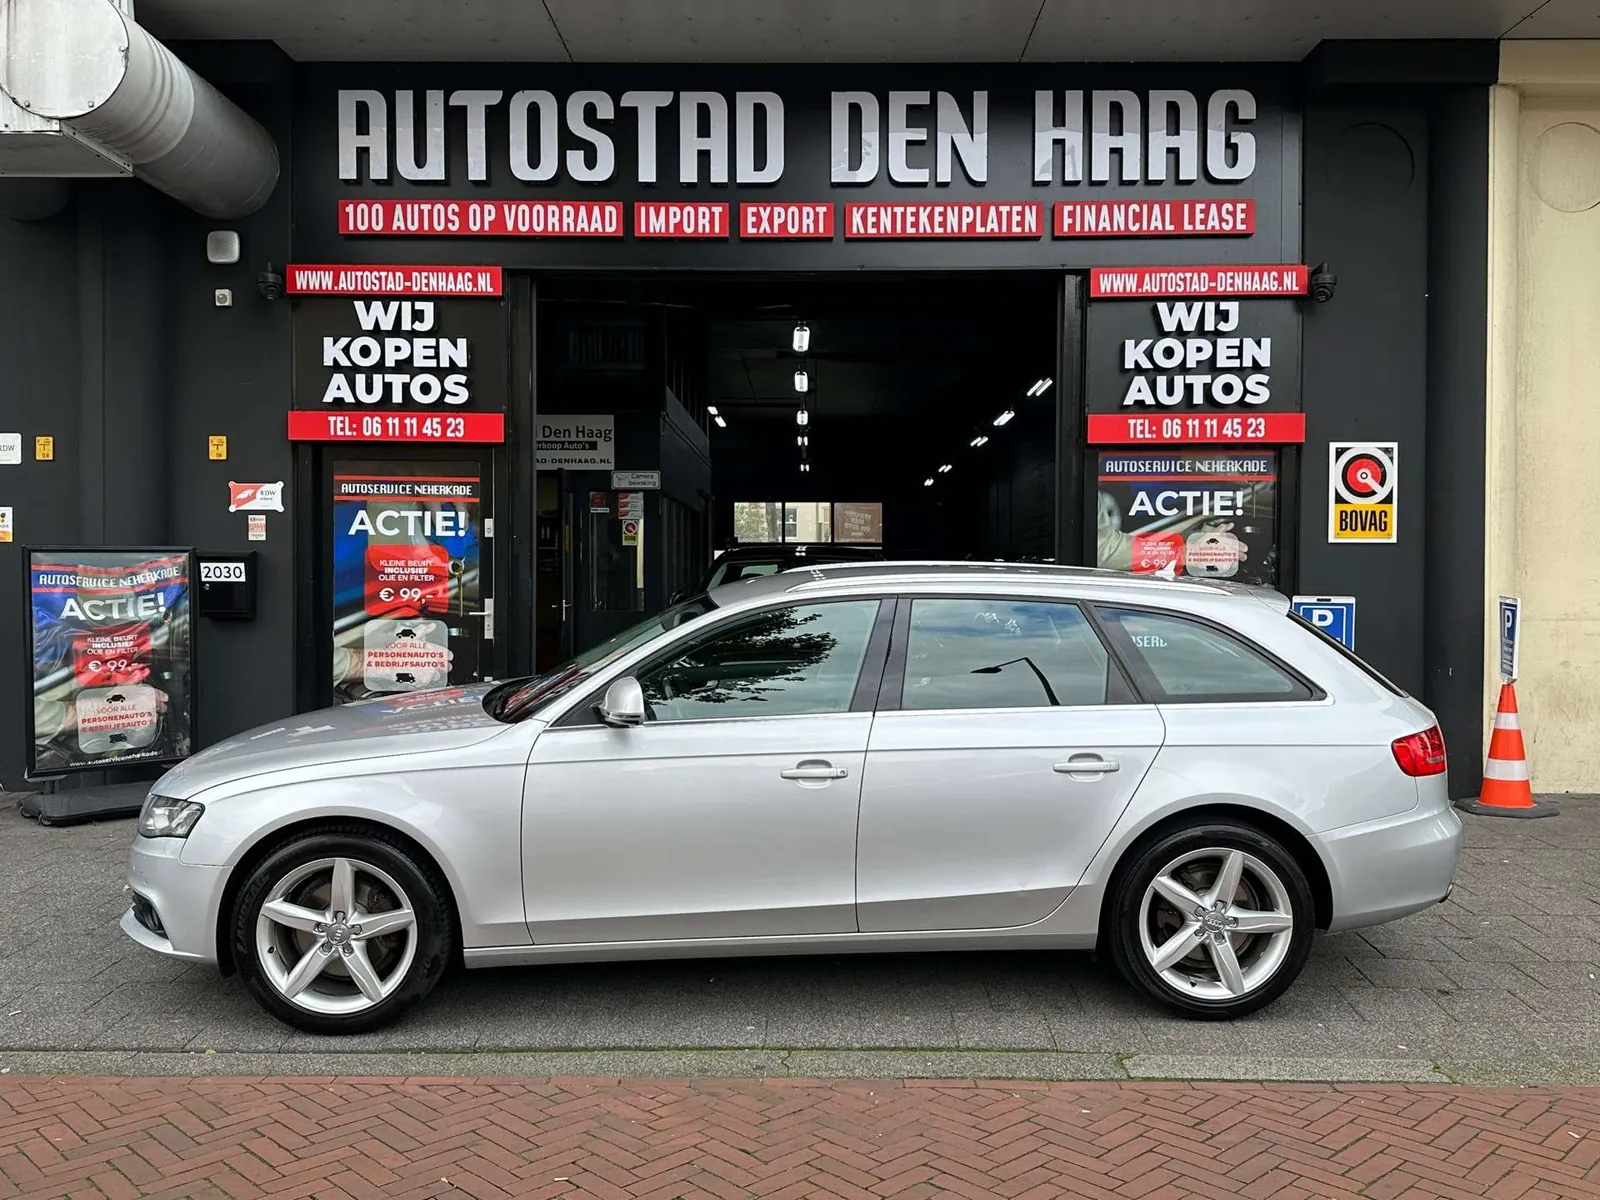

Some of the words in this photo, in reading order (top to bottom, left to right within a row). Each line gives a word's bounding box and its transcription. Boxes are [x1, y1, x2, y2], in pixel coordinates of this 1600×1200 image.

[338, 89, 785, 184] AUTOSTAD
[830, 90, 988, 184] DEN
[1033, 89, 1257, 183] HAAG
[344, 204, 384, 231] 100
[392, 204, 461, 233] AUTOS
[468, 205, 496, 233] OP
[502, 205, 618, 234] VOORRAAD
[640, 206, 723, 234] IMPORT
[746, 206, 827, 234] EXPORT
[851, 205, 1038, 234] KENTEKENPLATEN
[1062, 204, 1175, 232] FINANCIAL
[1182, 203, 1247, 231] LEASE
[295, 270, 494, 293] WWW.AUTOSTAD-DENHAAG.NL
[1100, 271, 1299, 293] WWW.AUTOSTAD-DENHAAG.NL
[353, 300, 435, 332] WIJ
[1156, 301, 1240, 332] WIJ
[323, 336, 468, 368] KOPEN
[1124, 337, 1271, 369] KOPEN
[322, 373, 469, 404] AUTOS
[1122, 373, 1270, 405] AUTOS
[328, 416, 357, 436] TEL:
[362, 416, 382, 436] 06
[386, 416, 400, 436] 11
[404, 417, 417, 437] 11
[422, 417, 442, 437] 45
[446, 417, 465, 437] 23
[542, 425, 571, 439] Den
[576, 425, 613, 442] Haag
[1128, 418, 1157, 438] TEL:
[1162, 418, 1182, 438] 06
[1186, 418, 1200, 438] 11
[1204, 418, 1218, 437] 11
[1222, 418, 1242, 437] 45
[1247, 417, 1266, 437] 23
[563, 442, 589, 450] Auto's
[1105, 460, 1193, 473] AUTOSERVICE
[1195, 460, 1268, 473] NEHERKADE
[341, 483, 412, 495] AUTOSERVICE
[414, 484, 472, 496] NEHERKADE
[1128, 490, 1244, 516] ACTIE!
[347, 509, 466, 537] ACTIE!
[1339, 510, 1388, 532] BOVAG
[203, 566, 243, 579] 2030
[379, 559, 406, 567] KLEINE
[407, 559, 432, 567] BEURT
[384, 567, 429, 575] INCLUSIEF
[1141, 559, 1151, 568] €
[39, 574, 119, 588] AUTOSERVICE
[119, 565, 181, 588] NEHERKADE
[378, 574, 396, 582] OLIE
[397, 574, 408, 582] EN
[410, 574, 435, 582] FILTER
[59, 592, 166, 621] ACTIE!
[379, 587, 395, 602] €
[399, 587, 434, 604] 99,-
[1504, 609, 1513, 638] P
[87, 635, 113, 643] KLEINE
[113, 634, 138, 642] BEURT
[92, 641, 134, 649] INCLUSIEF
[88, 660, 102, 672] €
[367, 651, 444, 659] PERSONENAUTO'S
[81, 711, 153, 724] PERSONENAUTO'S
